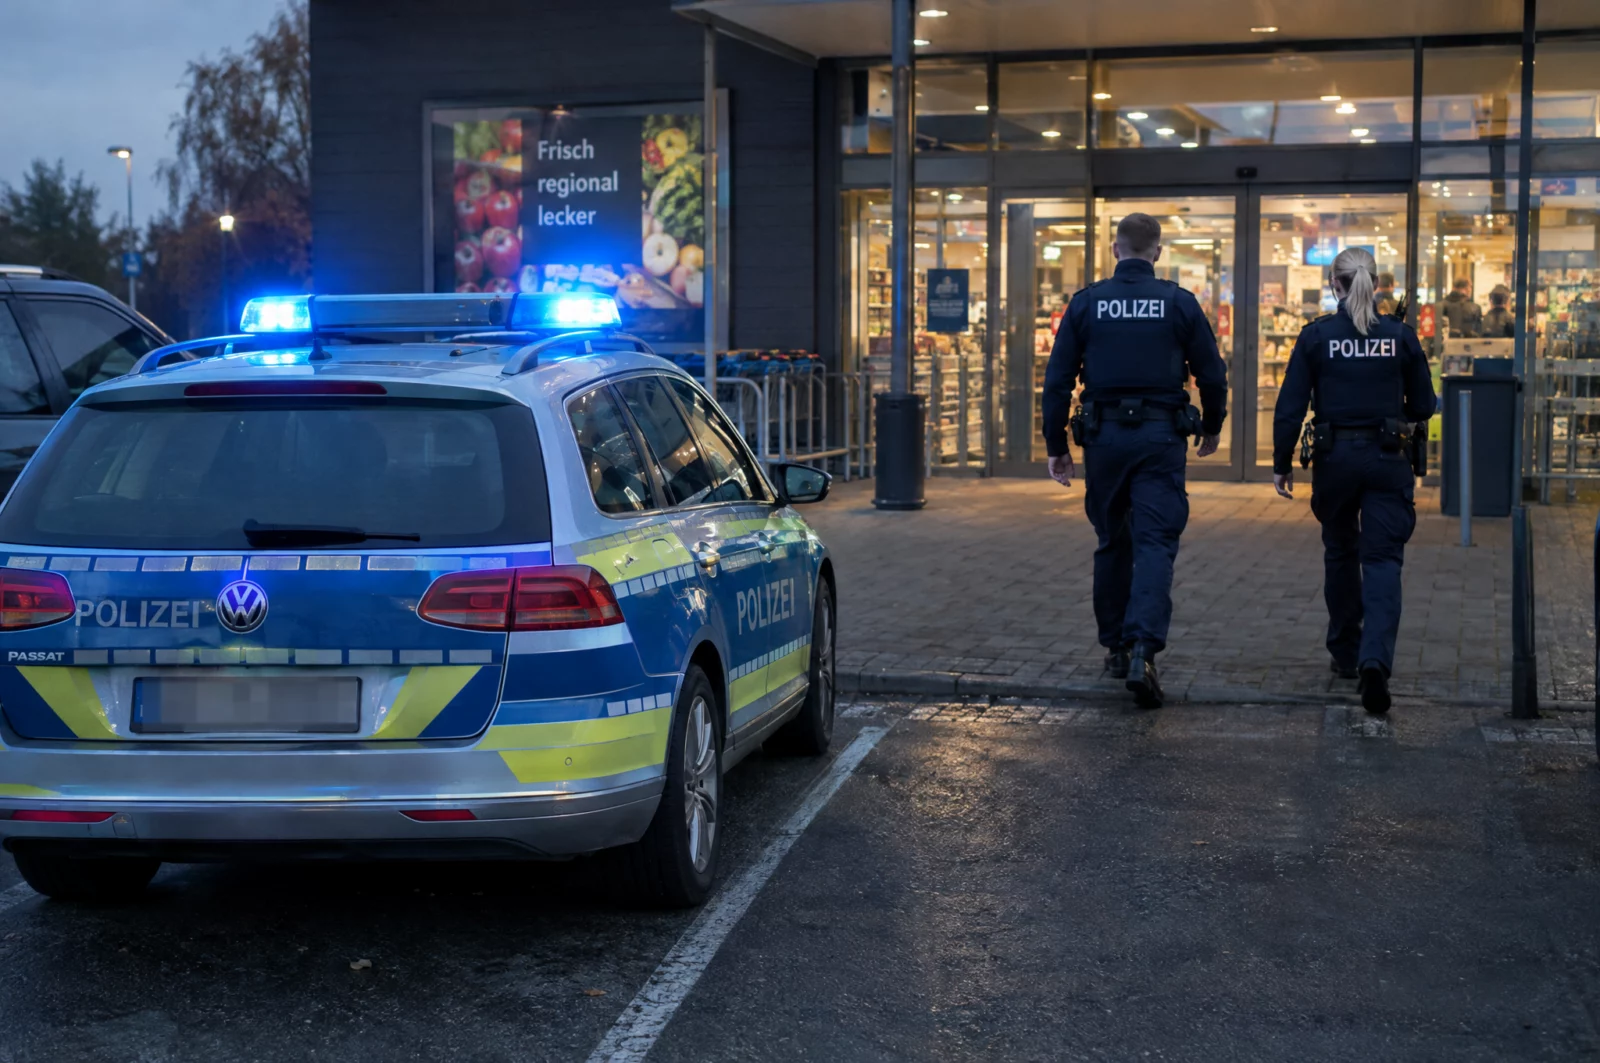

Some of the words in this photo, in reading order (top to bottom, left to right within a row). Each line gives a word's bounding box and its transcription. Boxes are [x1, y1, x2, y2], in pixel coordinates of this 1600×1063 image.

[538, 138, 594, 160] Frisch
[538, 170, 618, 198] regional
[538, 204, 597, 226] lecker
[1097, 299, 1165, 319] POLIZEI
[1329, 338, 1396, 358] POLIZEI
[75, 600, 201, 628] POLIZEI
[217, 581, 267, 632] VW
[737, 577, 795, 635] POLIZEI
[8, 651, 65, 662] PASSAT
